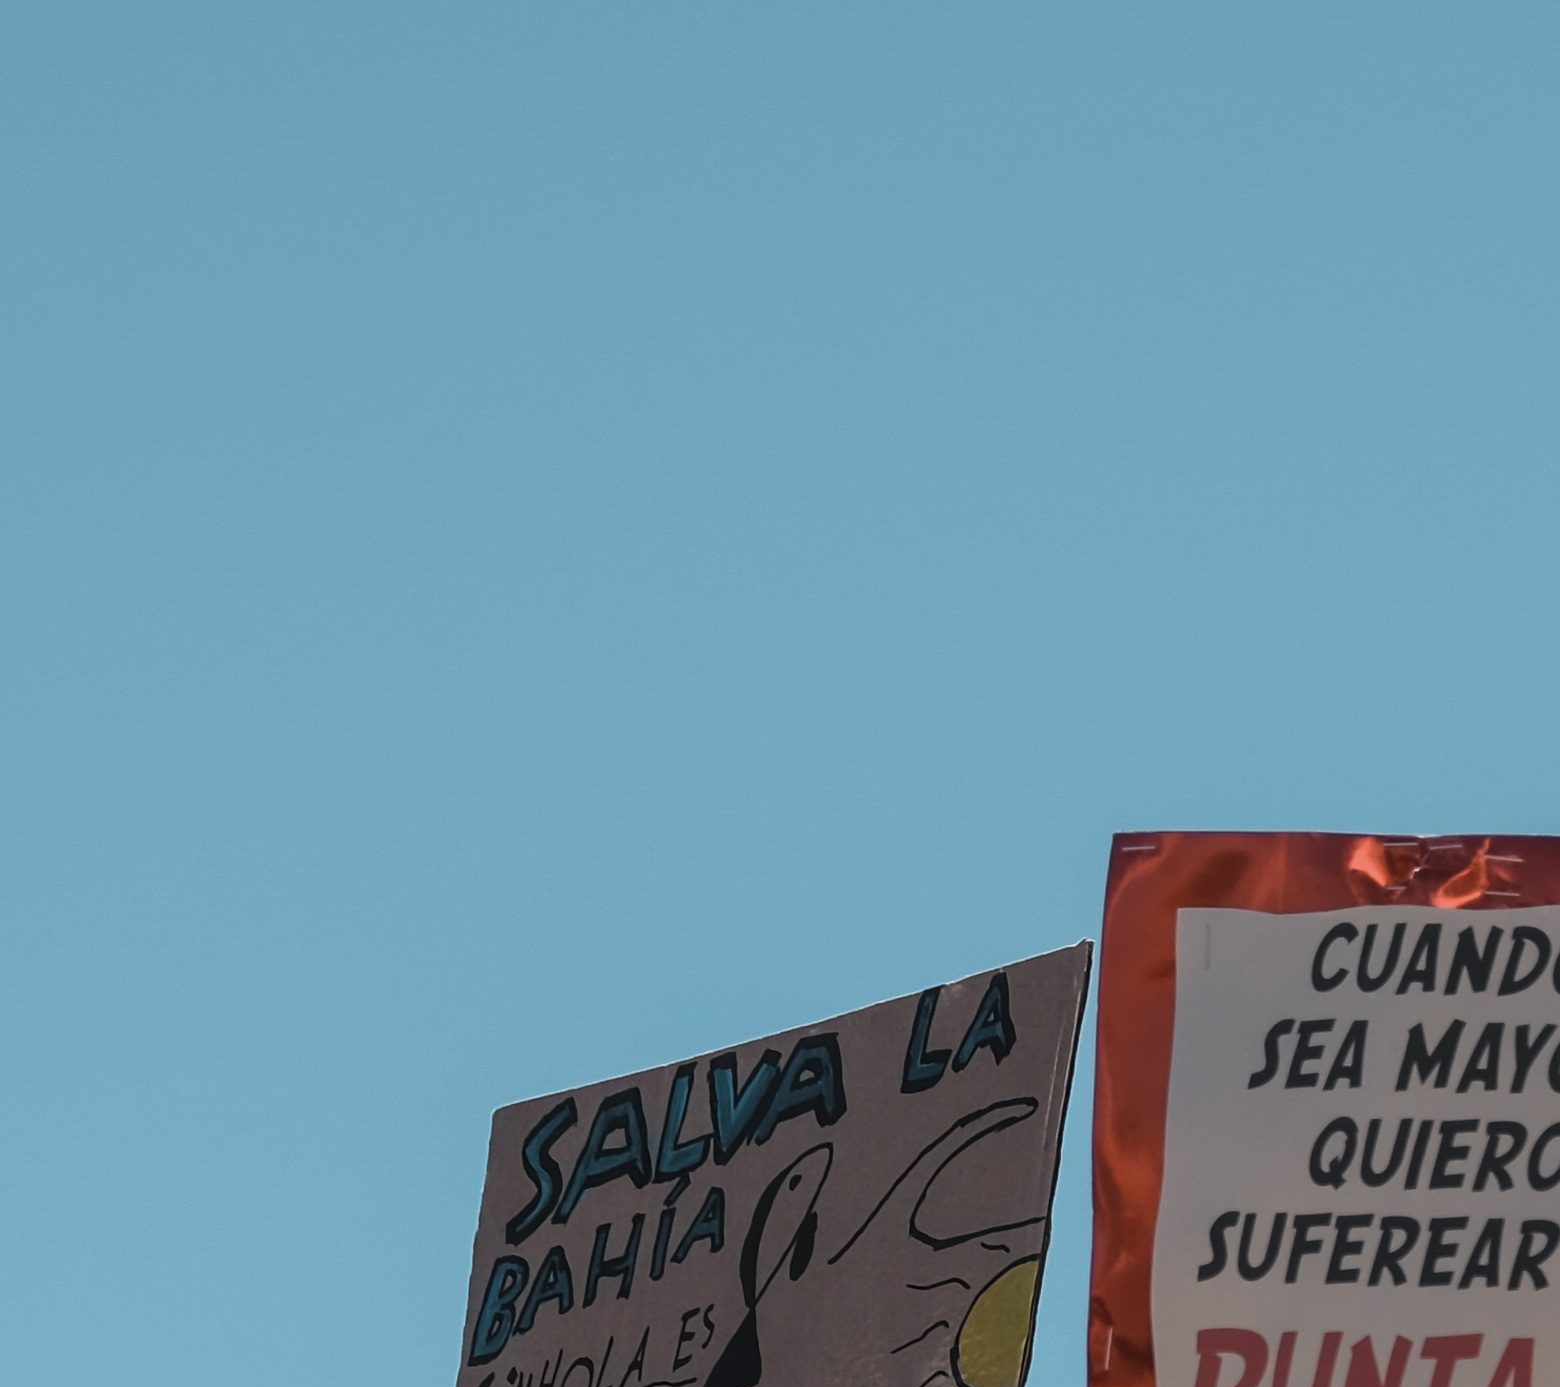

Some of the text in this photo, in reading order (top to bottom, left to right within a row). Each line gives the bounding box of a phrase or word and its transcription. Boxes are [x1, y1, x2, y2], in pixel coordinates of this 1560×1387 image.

[1247, 1018, 1370, 1092] SEA
[505, 971, 1017, 1246] SALVA LA
[466, 1168, 728, 1368] BAHÍA
[1196, 1209, 1560, 1293] SUFEREAR
[672, 1303, 716, 1374] ES
